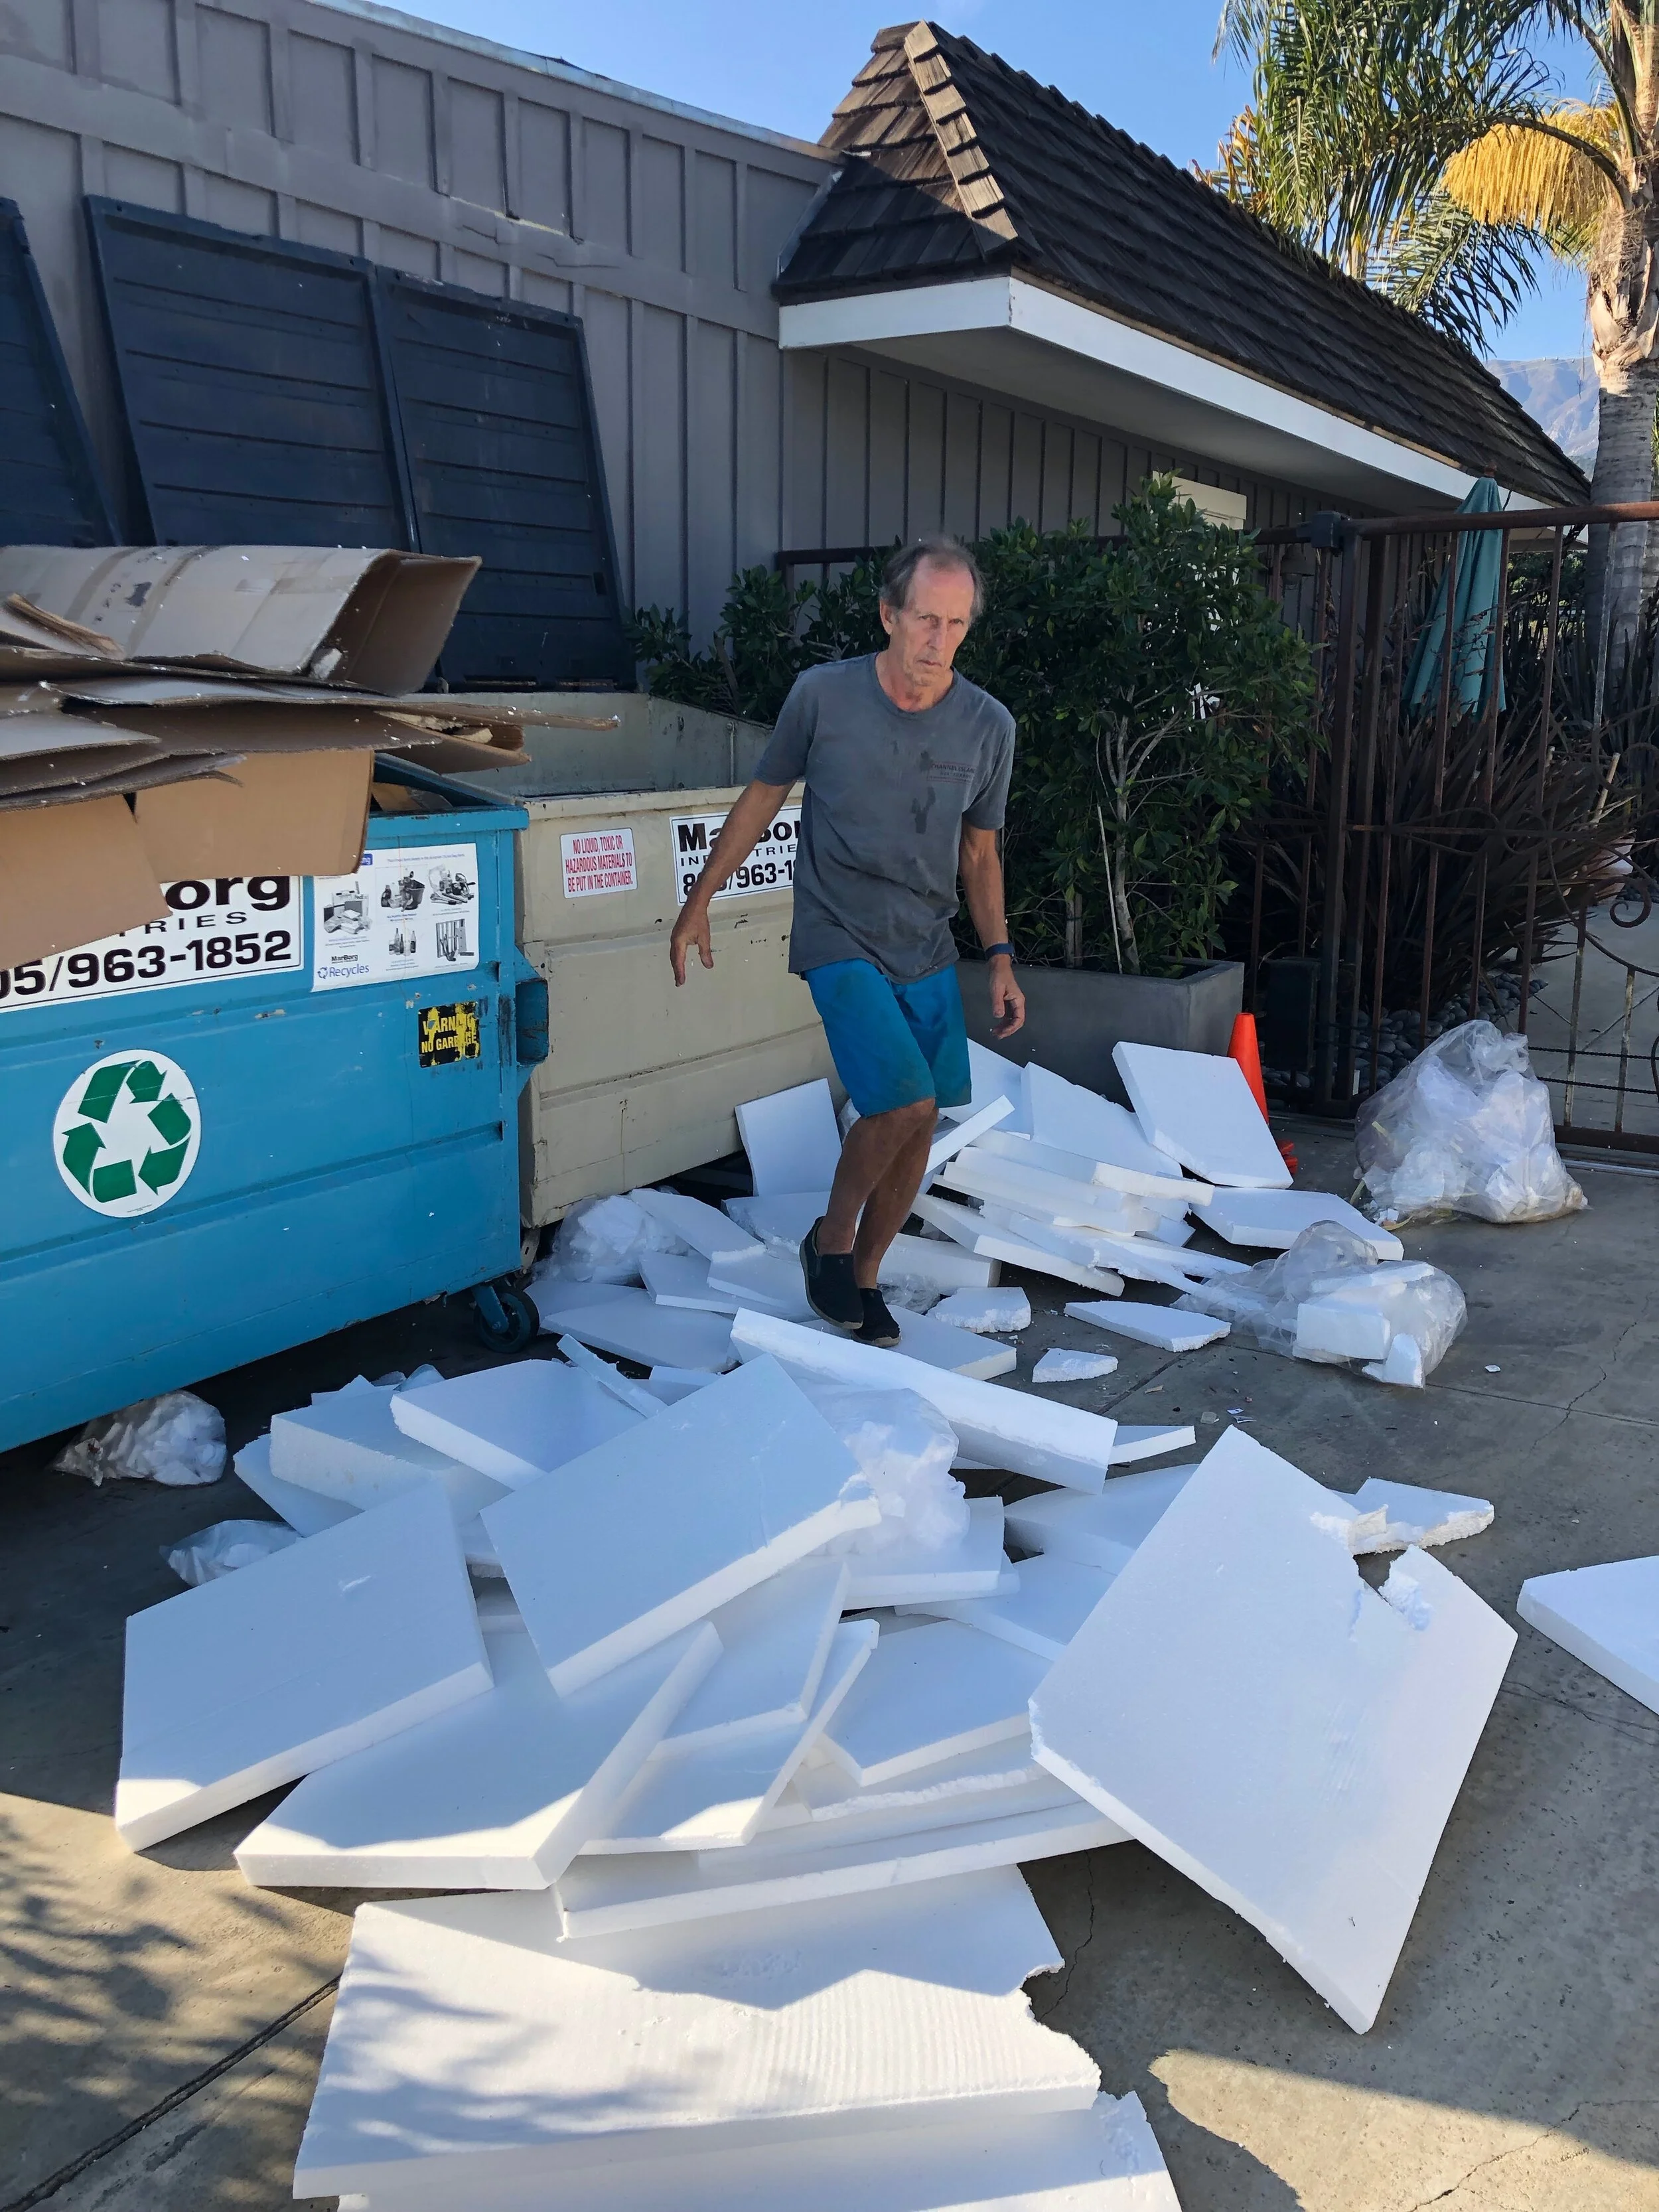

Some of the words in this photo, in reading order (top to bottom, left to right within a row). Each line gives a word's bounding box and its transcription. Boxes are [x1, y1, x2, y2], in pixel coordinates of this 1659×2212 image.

[573, 839, 581, 854] NO
[581, 837, 600, 853] LIQUID,
[600, 836, 615, 851] TOXIC
[616, 835, 623, 849] OR
[681, 844, 796, 866] INTRIE
[565, 856, 597, 873] HAZARDOUS
[597, 853, 625, 870] MATERIALS
[626, 852, 632, 867] TO
[568, 877, 575, 892] BE
[576, 876, 586, 891] PUT
[587, 875, 593, 889] IN
[594, 873, 604, 889] THE
[605, 870, 633, 887] CONTAINER.
[0, 930, 291, 995] 5/963-1852
[329, 964, 370, 978] Recycles
[421, 1040, 434, 1053] NO
